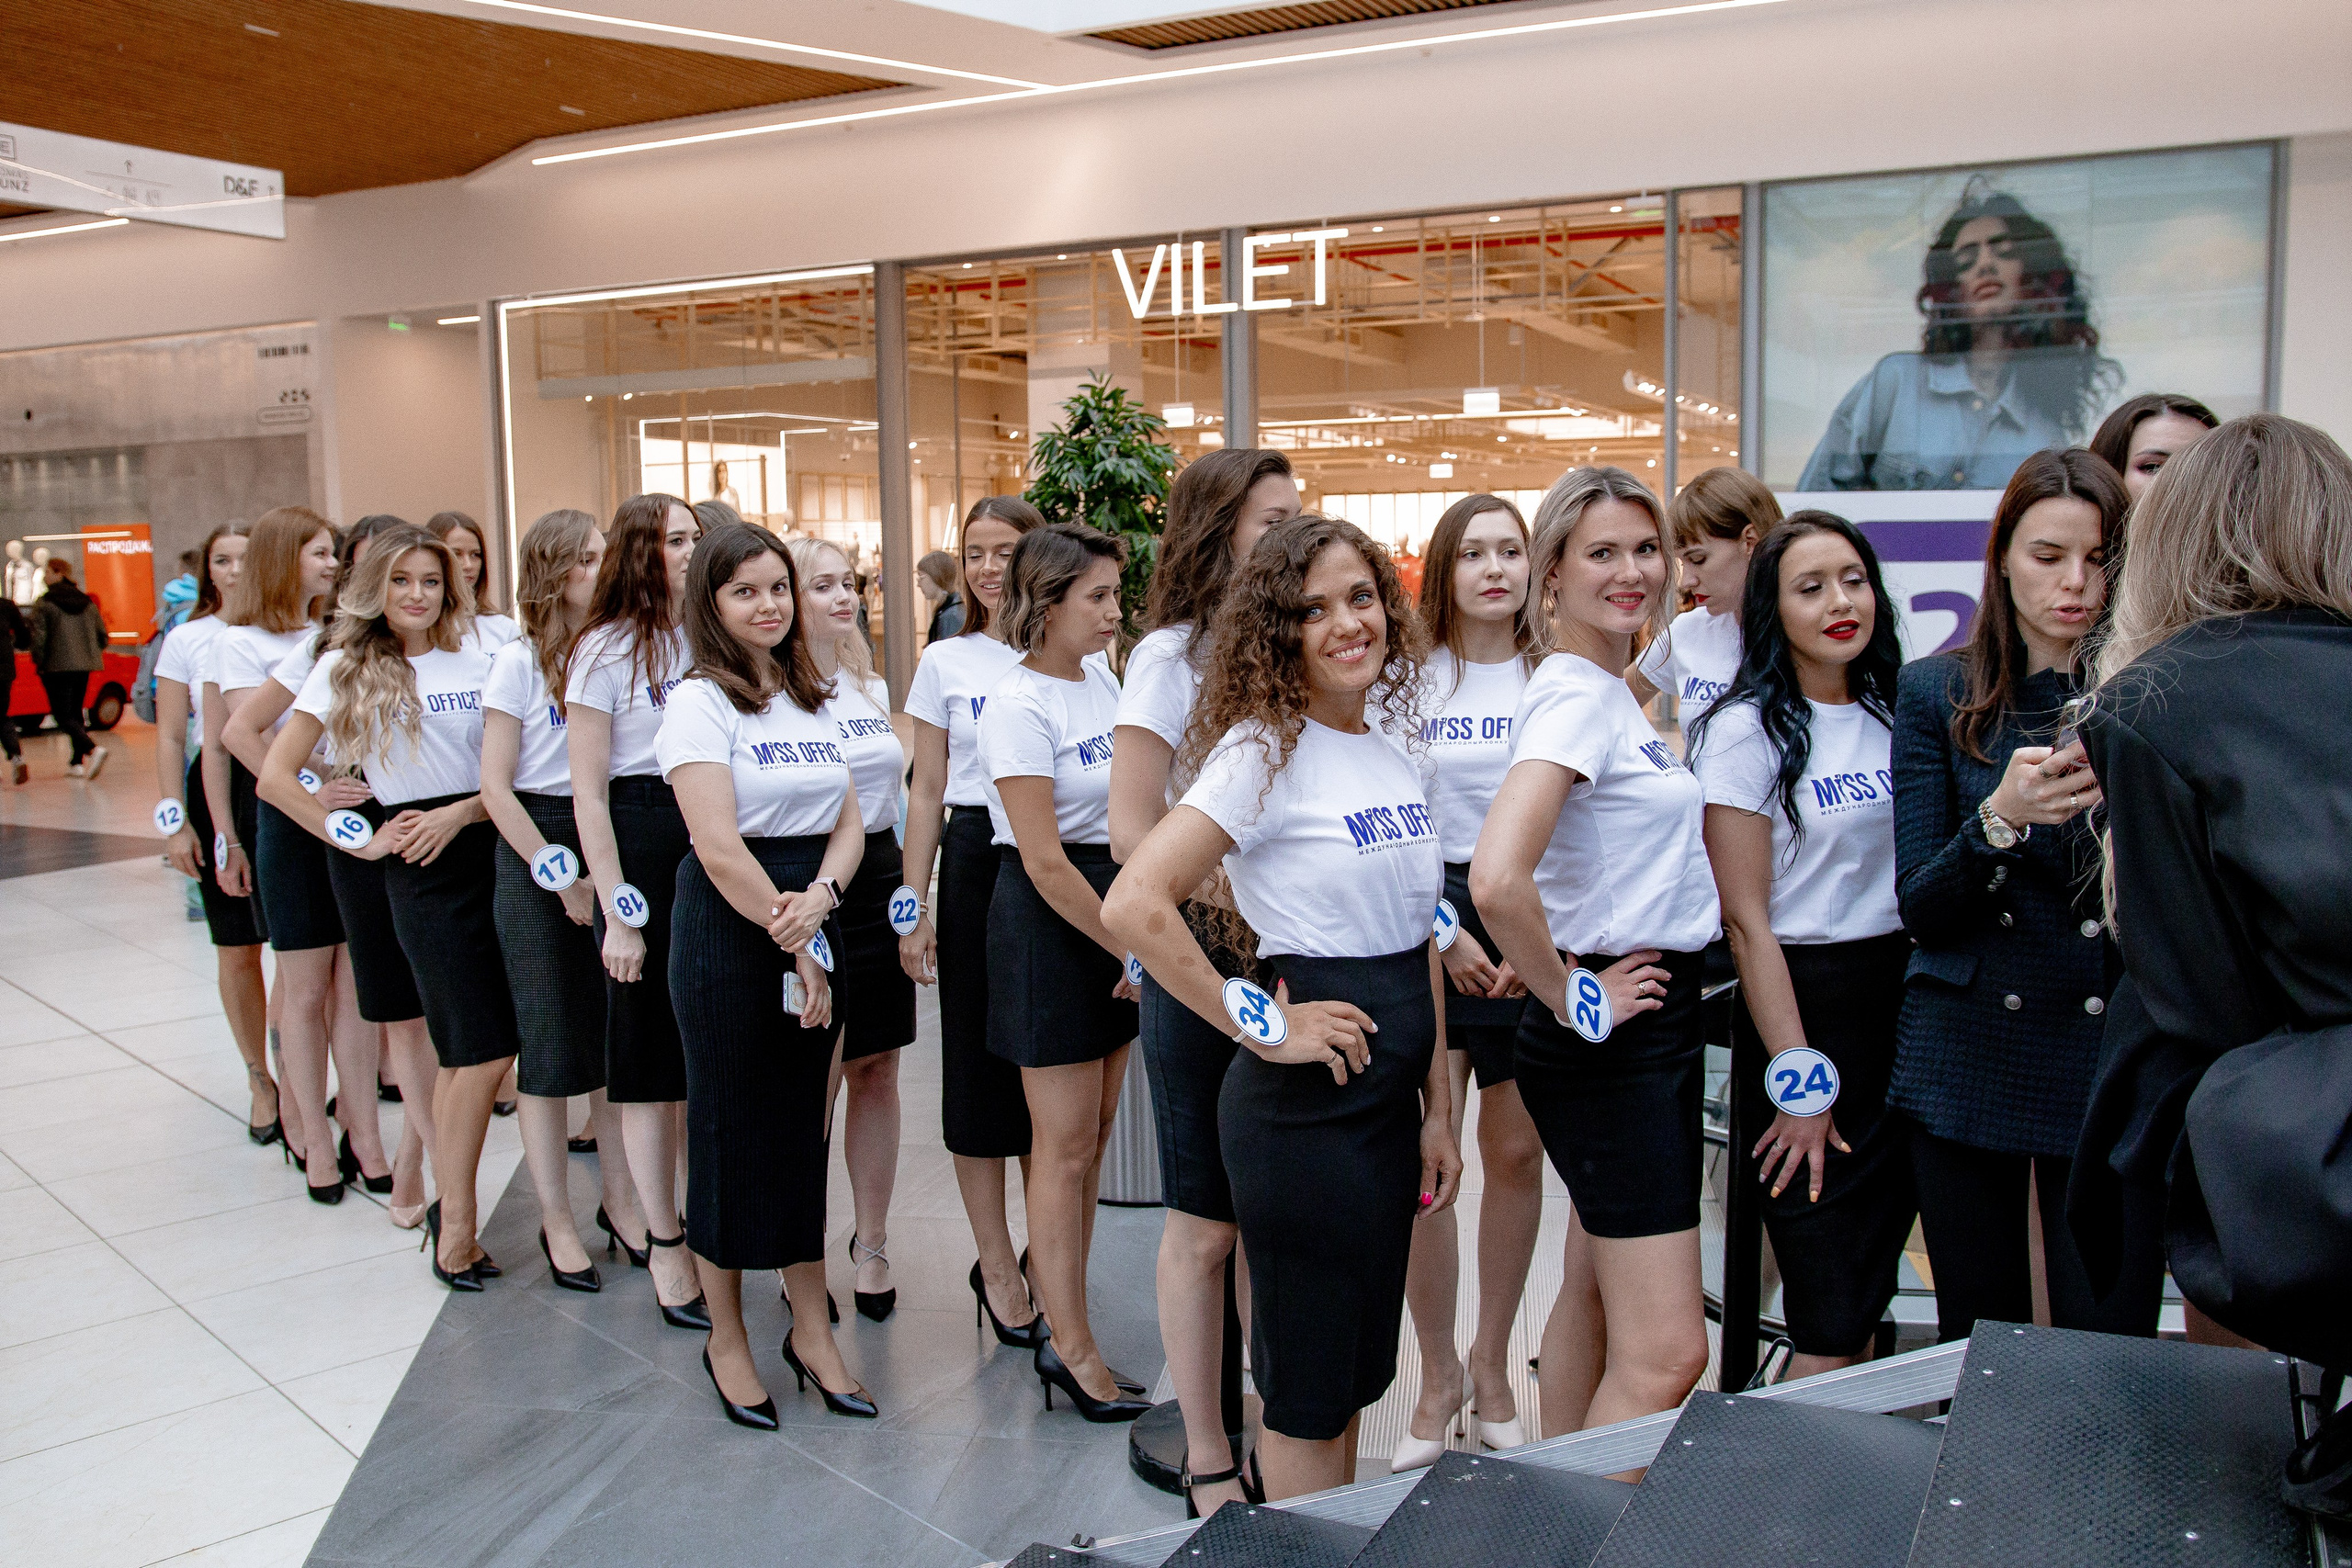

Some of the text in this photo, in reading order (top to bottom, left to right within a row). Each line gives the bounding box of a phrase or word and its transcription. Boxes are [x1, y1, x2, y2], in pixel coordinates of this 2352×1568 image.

[1111, 227, 1349, 320] VILET
[427, 691, 480, 712] OFFICE
[298, 771, 314, 784] 5
[158, 807, 180, 827] 12
[335, 817, 365, 841] 16
[537, 851, 569, 883] 17
[616, 892, 643, 918] 18
[892, 898, 917, 924] 22
[1238, 986, 1270, 1038] 34
[1576, 976, 1601, 1037] 20
[1775, 1063, 1833, 1103] 24
